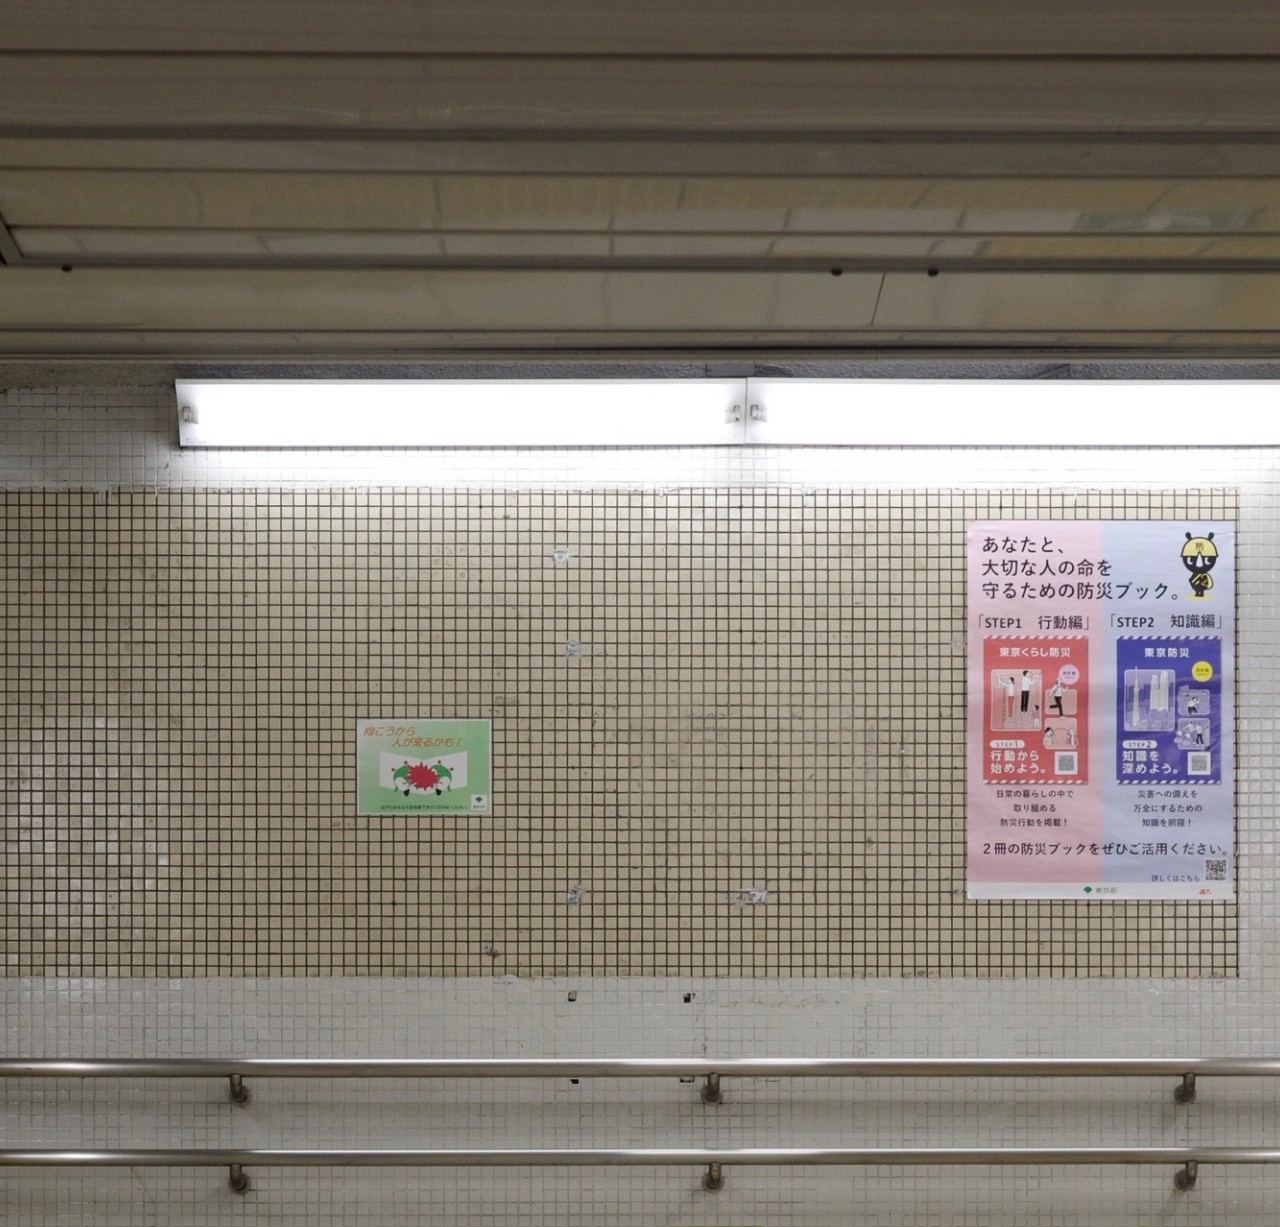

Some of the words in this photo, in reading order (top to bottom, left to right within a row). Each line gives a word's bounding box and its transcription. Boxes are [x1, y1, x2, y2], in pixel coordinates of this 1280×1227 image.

[982, 536, 1066, 555] あなたと、
[982, 559, 1112, 577] 大切な人の命を
[982, 582, 1179, 601] 守るための防災ブック。
[999, 647, 1071, 658] 東京くらし防災
[1144, 647, 1190, 658] 東京防災
[363, 727, 416, 737] 向こうから
[391, 737, 462, 748] 人が来るかも！
[990, 750, 1040, 761] 行動から
[1122, 750, 1160, 761] 知識を
[990, 763, 1046, 774] 始めよう。
[1122, 763, 1179, 774] 深めよう。
[996, 789, 1074, 799] 日常の暮らしの中で
[1137, 789, 1198, 799] 災害への備えを
[1013, 804, 1057, 813] 取り組める
[1133, 804, 1203, 813] 万全にするための
[1151, 874, 1200, 882] 詳しくはこちら
